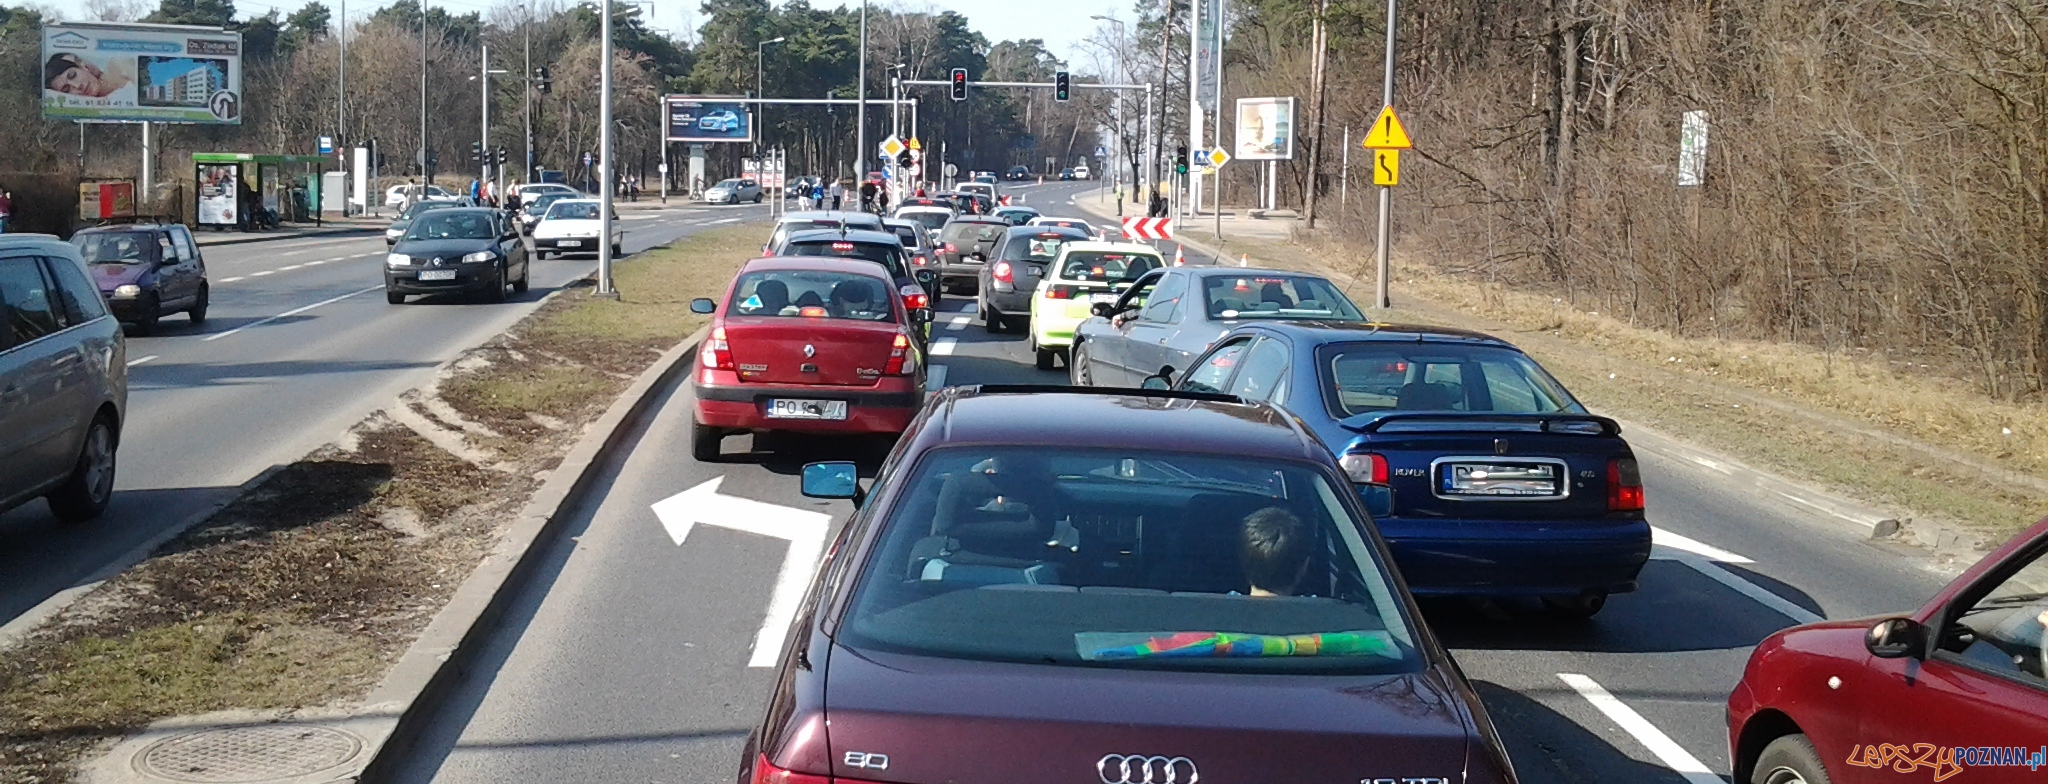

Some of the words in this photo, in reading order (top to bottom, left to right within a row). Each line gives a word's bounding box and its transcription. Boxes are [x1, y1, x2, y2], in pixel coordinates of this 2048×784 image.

[776, 400, 797, 414] PO
[1395, 467, 1426, 477] ROVER
[844, 751, 889, 770] 80
